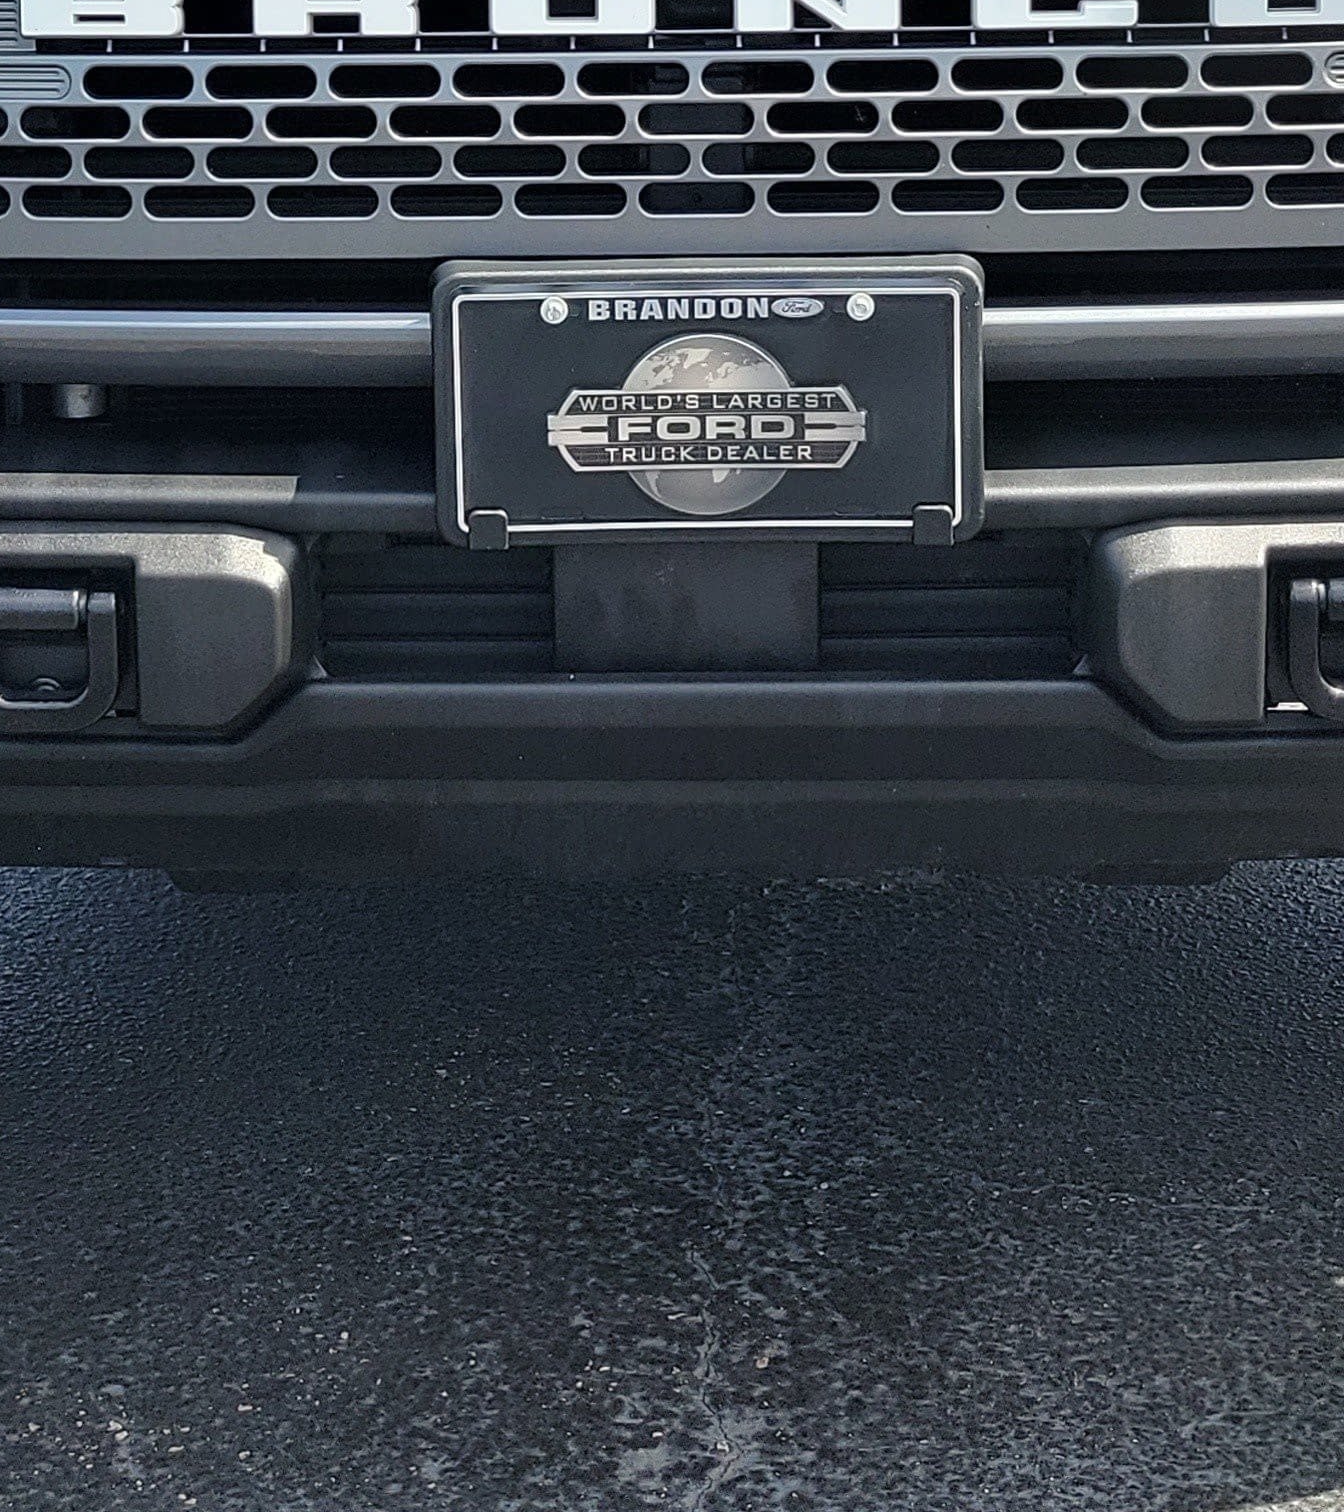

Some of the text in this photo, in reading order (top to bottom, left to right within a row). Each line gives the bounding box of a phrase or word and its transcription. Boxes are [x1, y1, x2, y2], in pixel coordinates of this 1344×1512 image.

[587, 297, 769, 321] BRANDON
[578, 393, 837, 412] WORLD'S LARGEST
[617, 415, 796, 441] FORD
[605, 445, 812, 463] TRUCK DEALER
